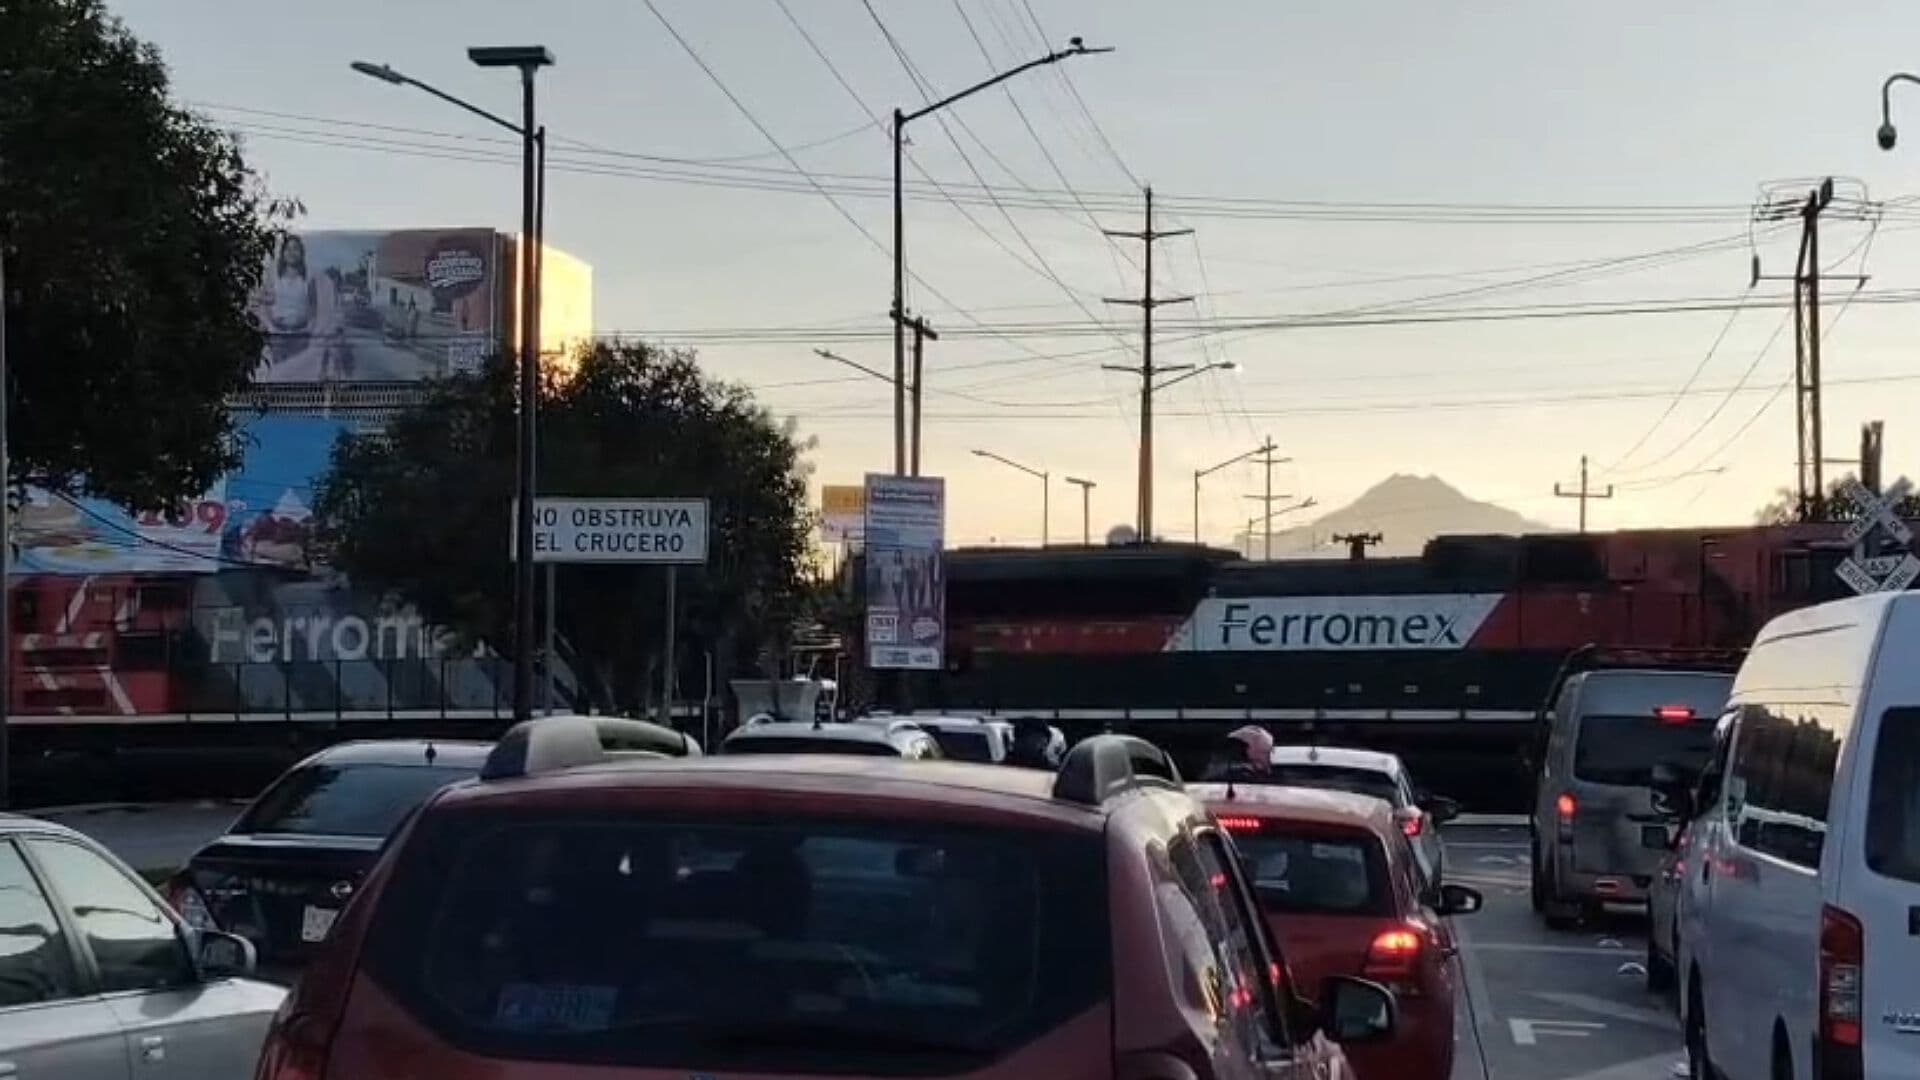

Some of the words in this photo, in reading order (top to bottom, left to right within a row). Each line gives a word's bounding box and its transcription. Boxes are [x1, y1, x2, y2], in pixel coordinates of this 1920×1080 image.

[572, 508, 692, 527] OBSTRUYA
[535, 533, 561, 552] EL
[575, 533, 684, 552] CRUCERO
[1219, 603, 1459, 645] Ferromex
